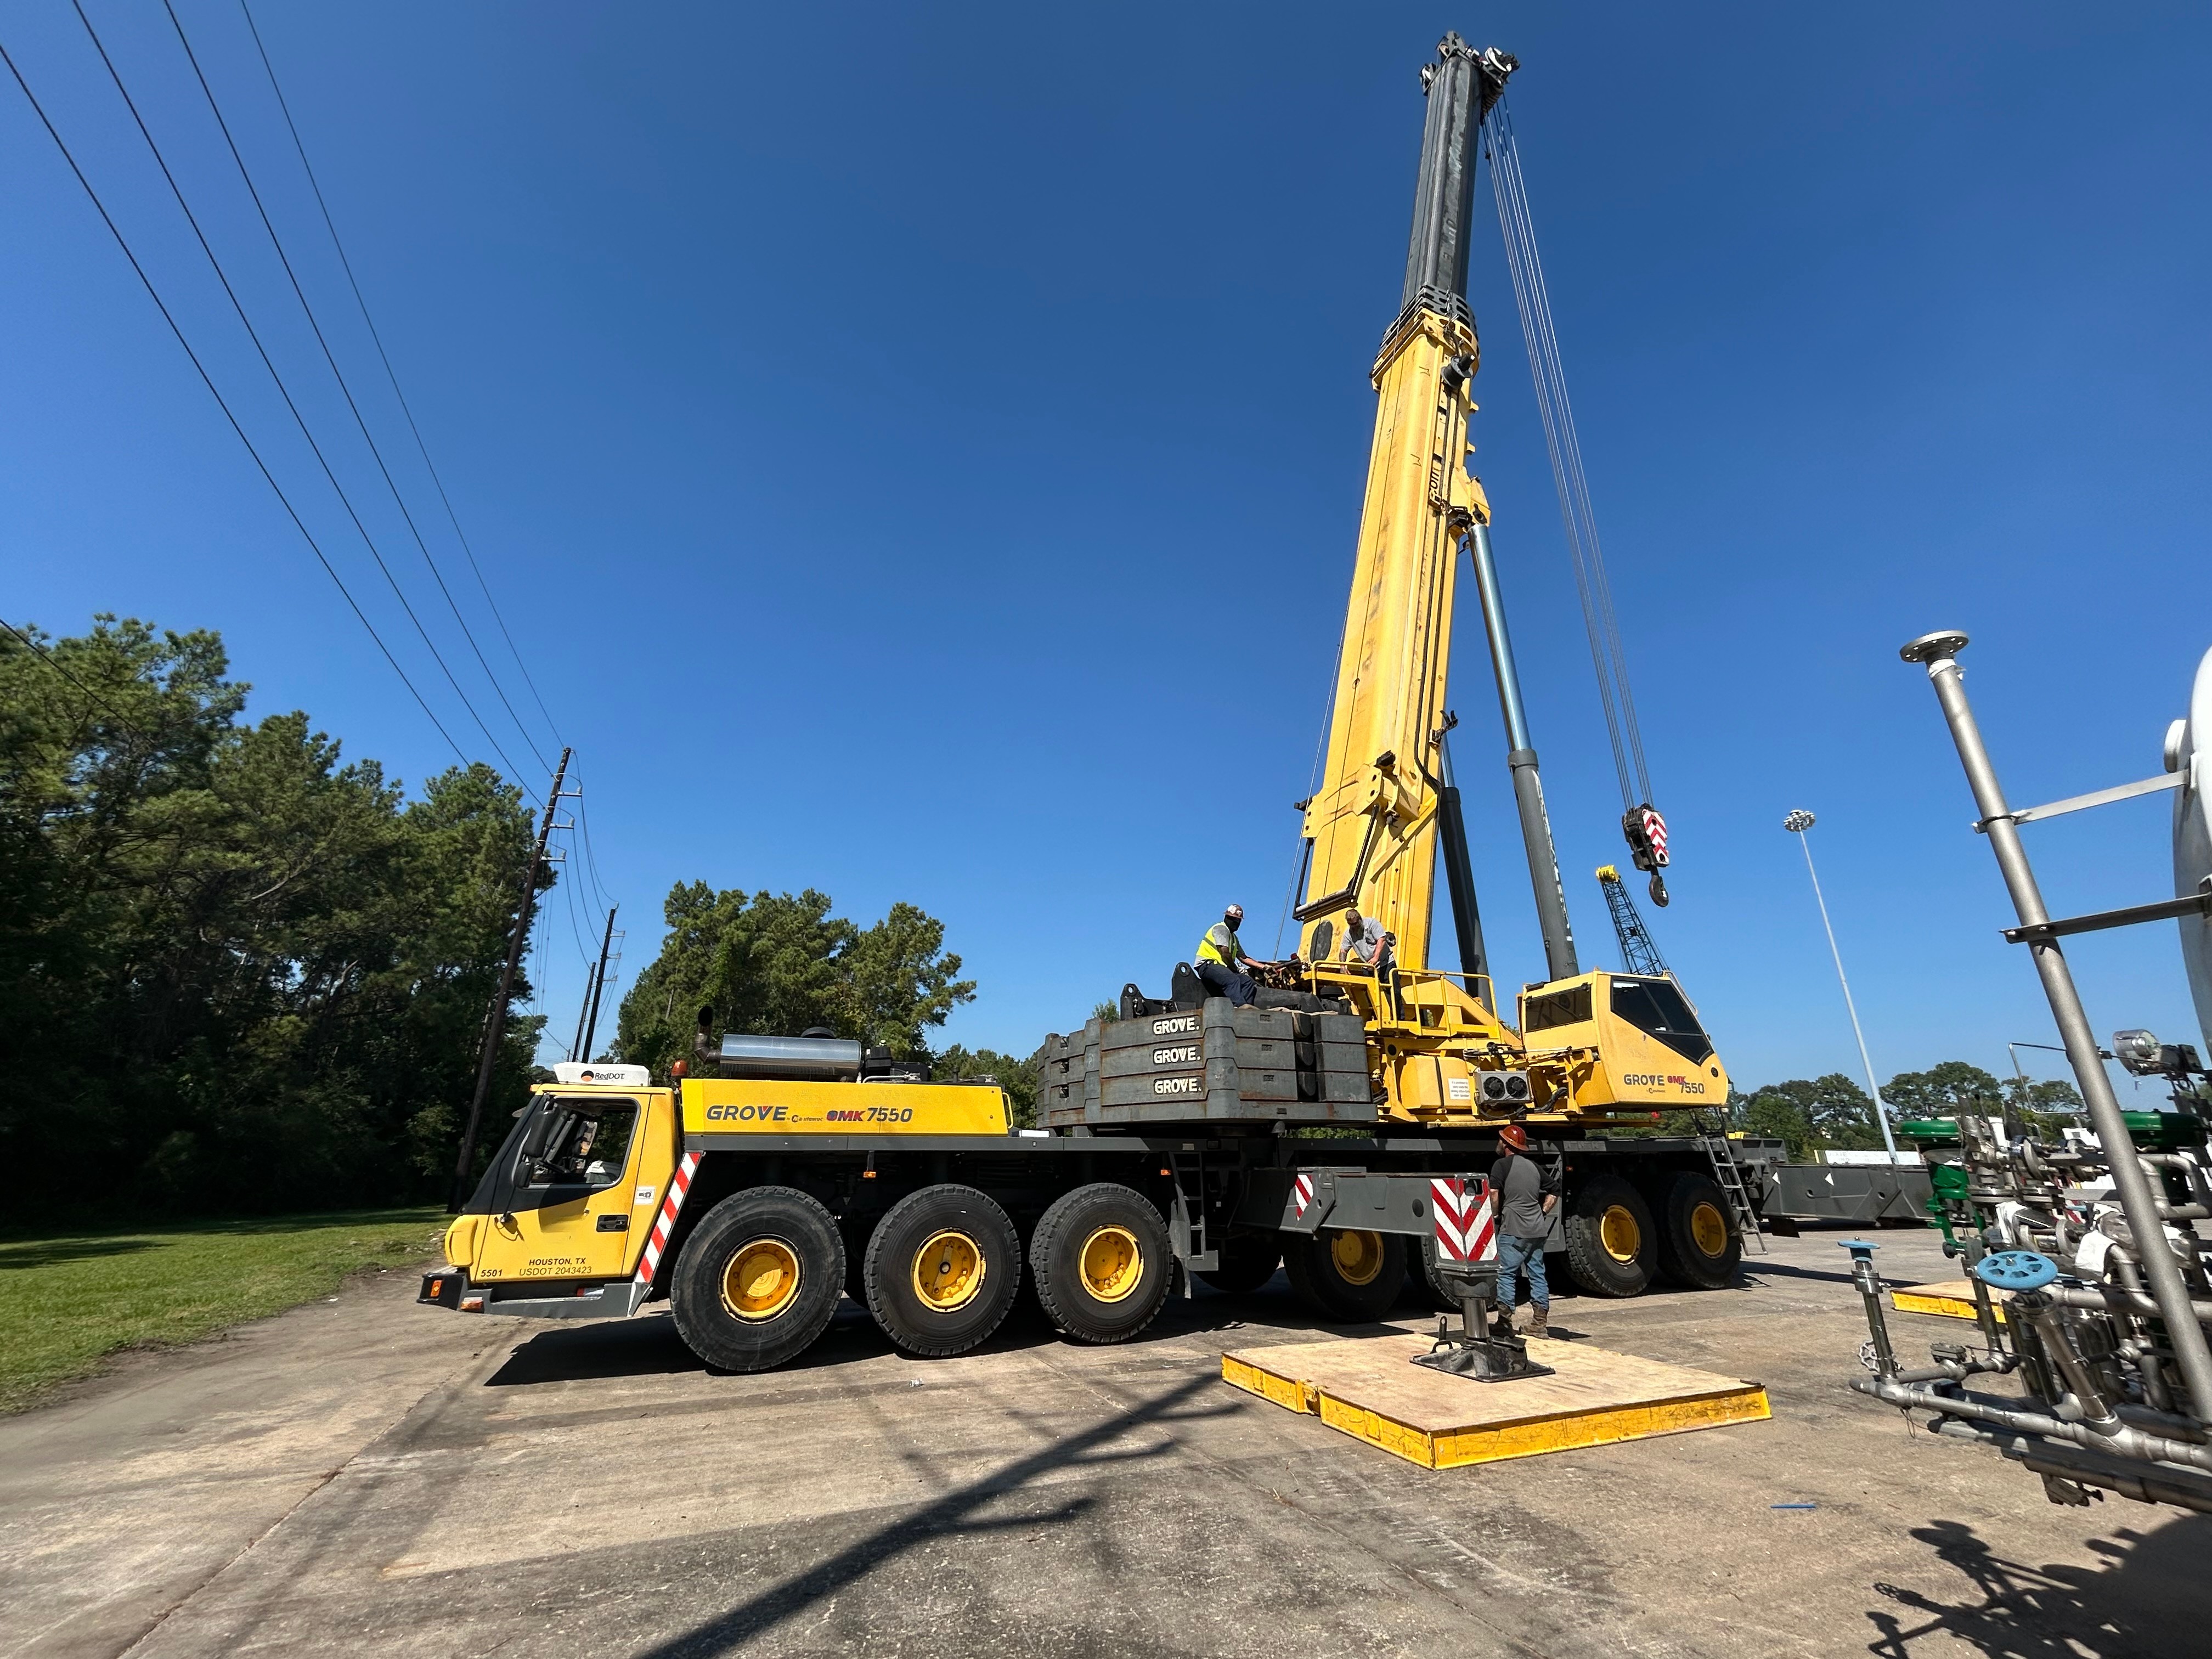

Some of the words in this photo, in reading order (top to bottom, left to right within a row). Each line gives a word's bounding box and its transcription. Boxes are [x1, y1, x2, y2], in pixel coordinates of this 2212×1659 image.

[1623, 1074, 1665, 1086] GROVE
[1680, 1082, 1705, 1094] 7550
[707, 1105, 788, 1121] GROVE
[866, 1107, 913, 1122] 7550
[481, 1269, 503, 1277] 5501
[519, 1267, 552, 1276] USDOT
[555, 1266, 592, 1275] 2043423
